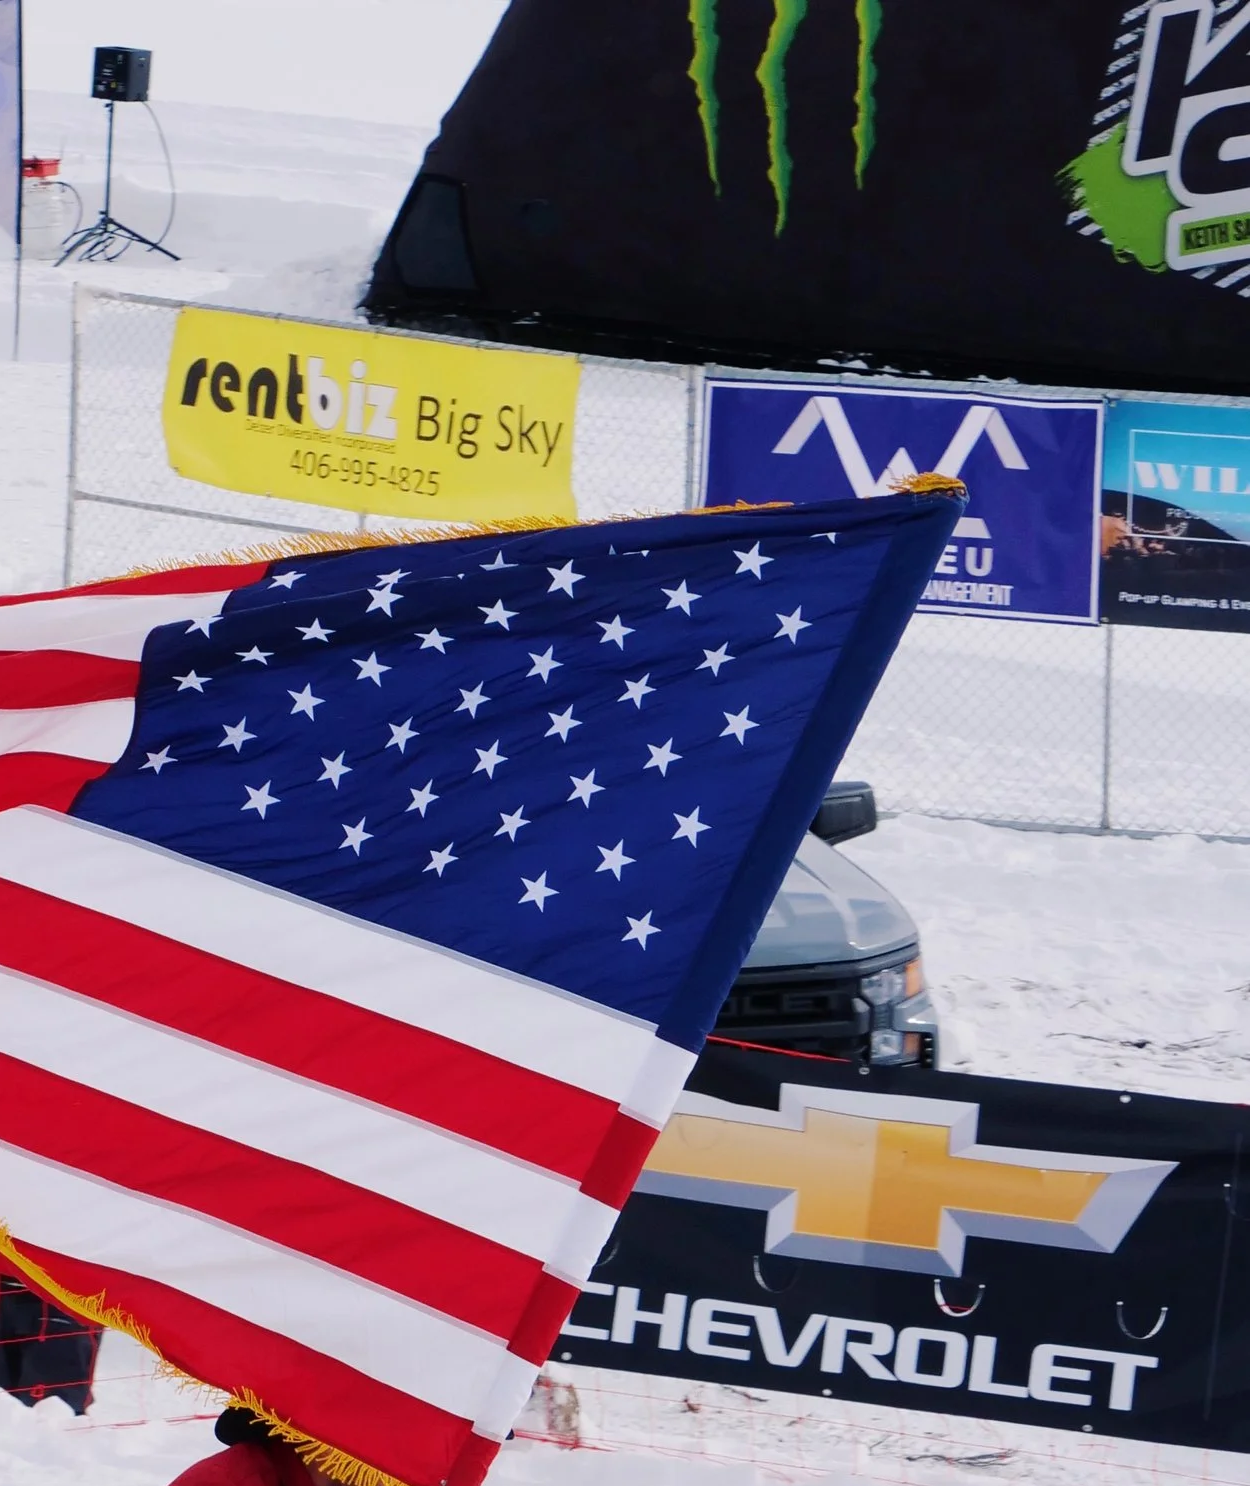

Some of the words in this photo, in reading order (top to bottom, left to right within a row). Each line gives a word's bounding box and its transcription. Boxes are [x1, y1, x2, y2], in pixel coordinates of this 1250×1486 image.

[1183, 221, 1229, 251] KEITH
[180, 353, 399, 440] rentbiz
[415, 395, 483, 459] Big
[495, 404, 564, 468] Sky
[290, 449, 441, 497] 406-995-4825
[920, 579, 1014, 606] ANAGEMENT
[559, 1280, 1158, 1411] CHEVROLET
